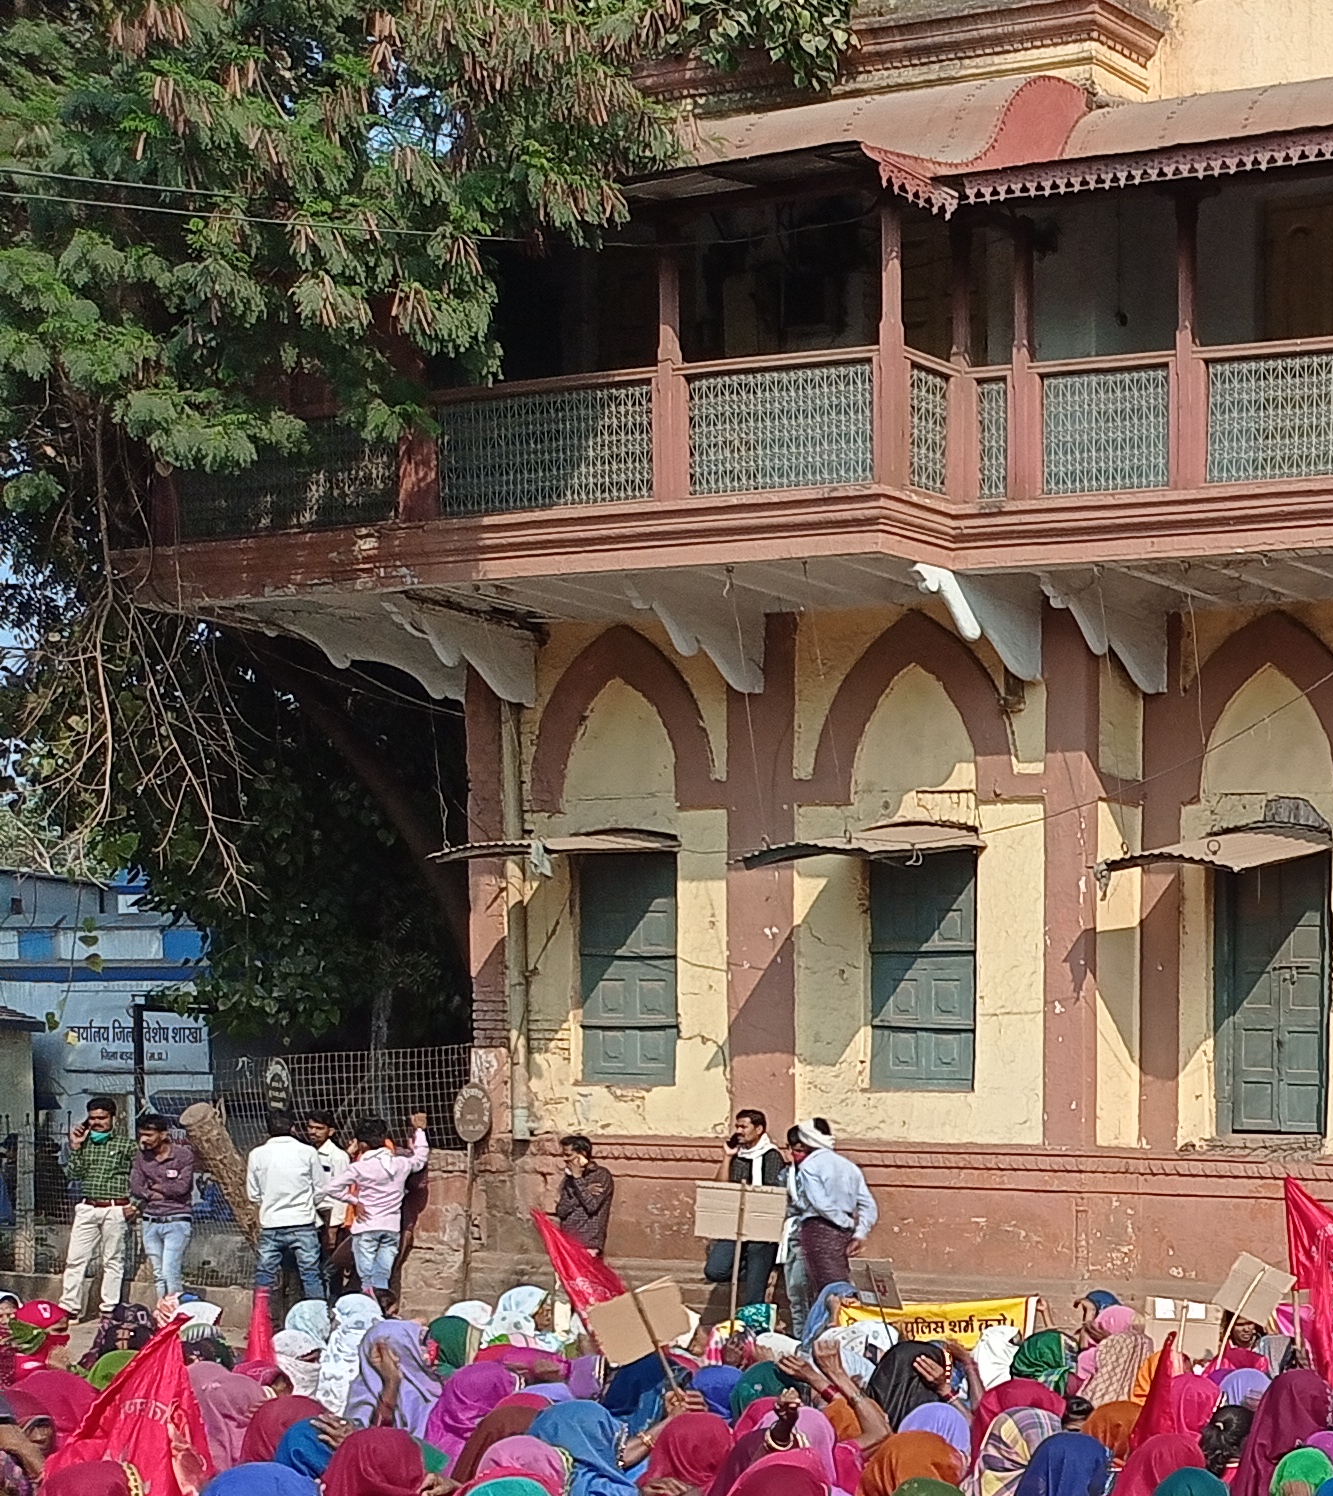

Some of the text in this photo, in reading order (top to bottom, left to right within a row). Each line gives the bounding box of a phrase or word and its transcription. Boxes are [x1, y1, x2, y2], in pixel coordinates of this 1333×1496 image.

[172, 1026, 203, 1043] शाखा
[903, 1316, 945, 1338] पुलिस
[949, 1315, 974, 1333] शर्म
